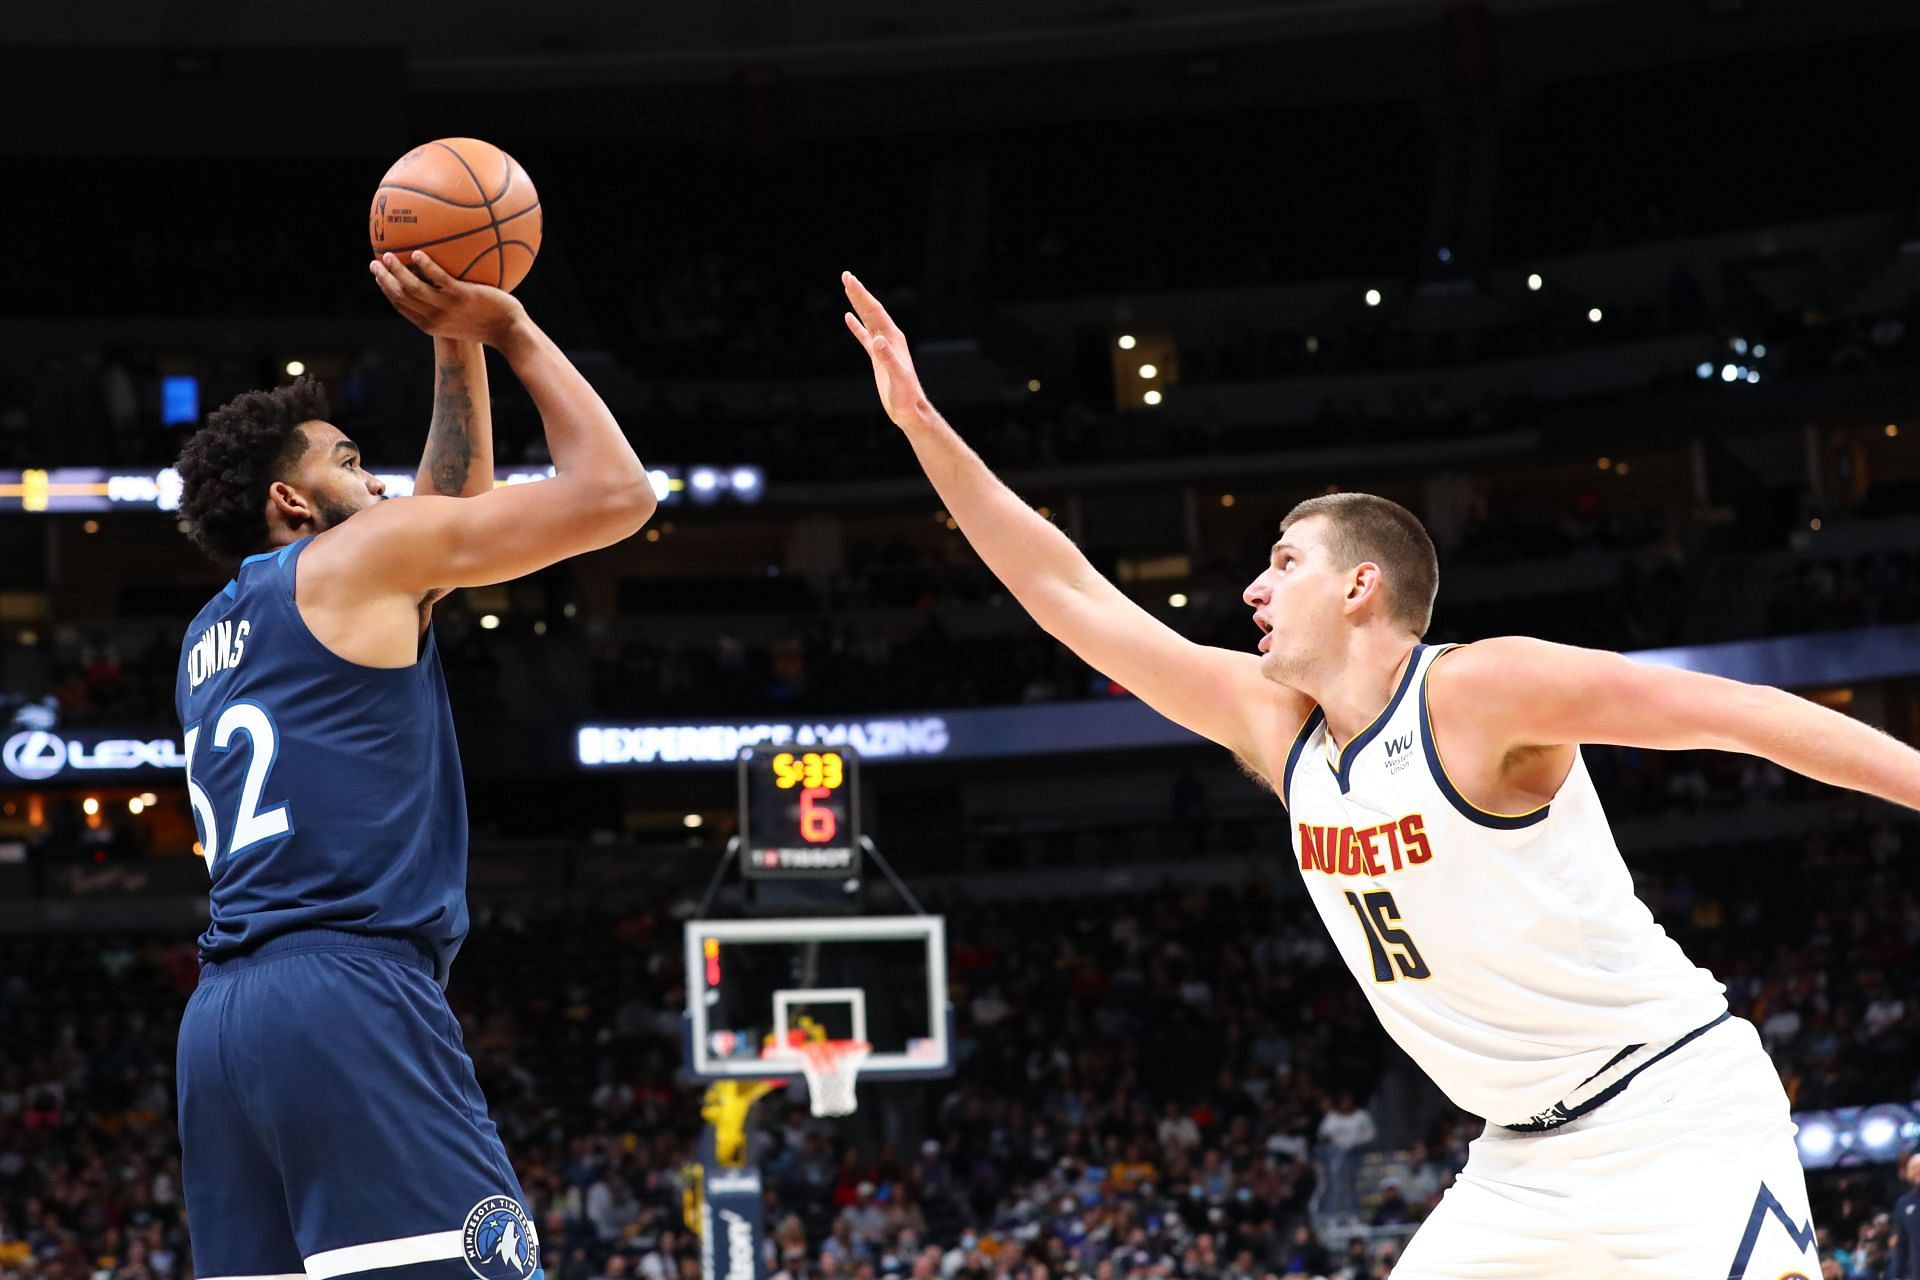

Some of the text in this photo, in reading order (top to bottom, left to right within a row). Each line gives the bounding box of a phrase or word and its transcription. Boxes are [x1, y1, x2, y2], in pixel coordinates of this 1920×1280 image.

[772, 752, 843, 789] 5:33
[1384, 729, 1413, 758] WU
[800, 786, 836, 843] 6
[1297, 813, 1433, 877] NUGETS
[1343, 888, 1432, 984] 15
[466, 1202, 496, 1259] MINNESOTA
